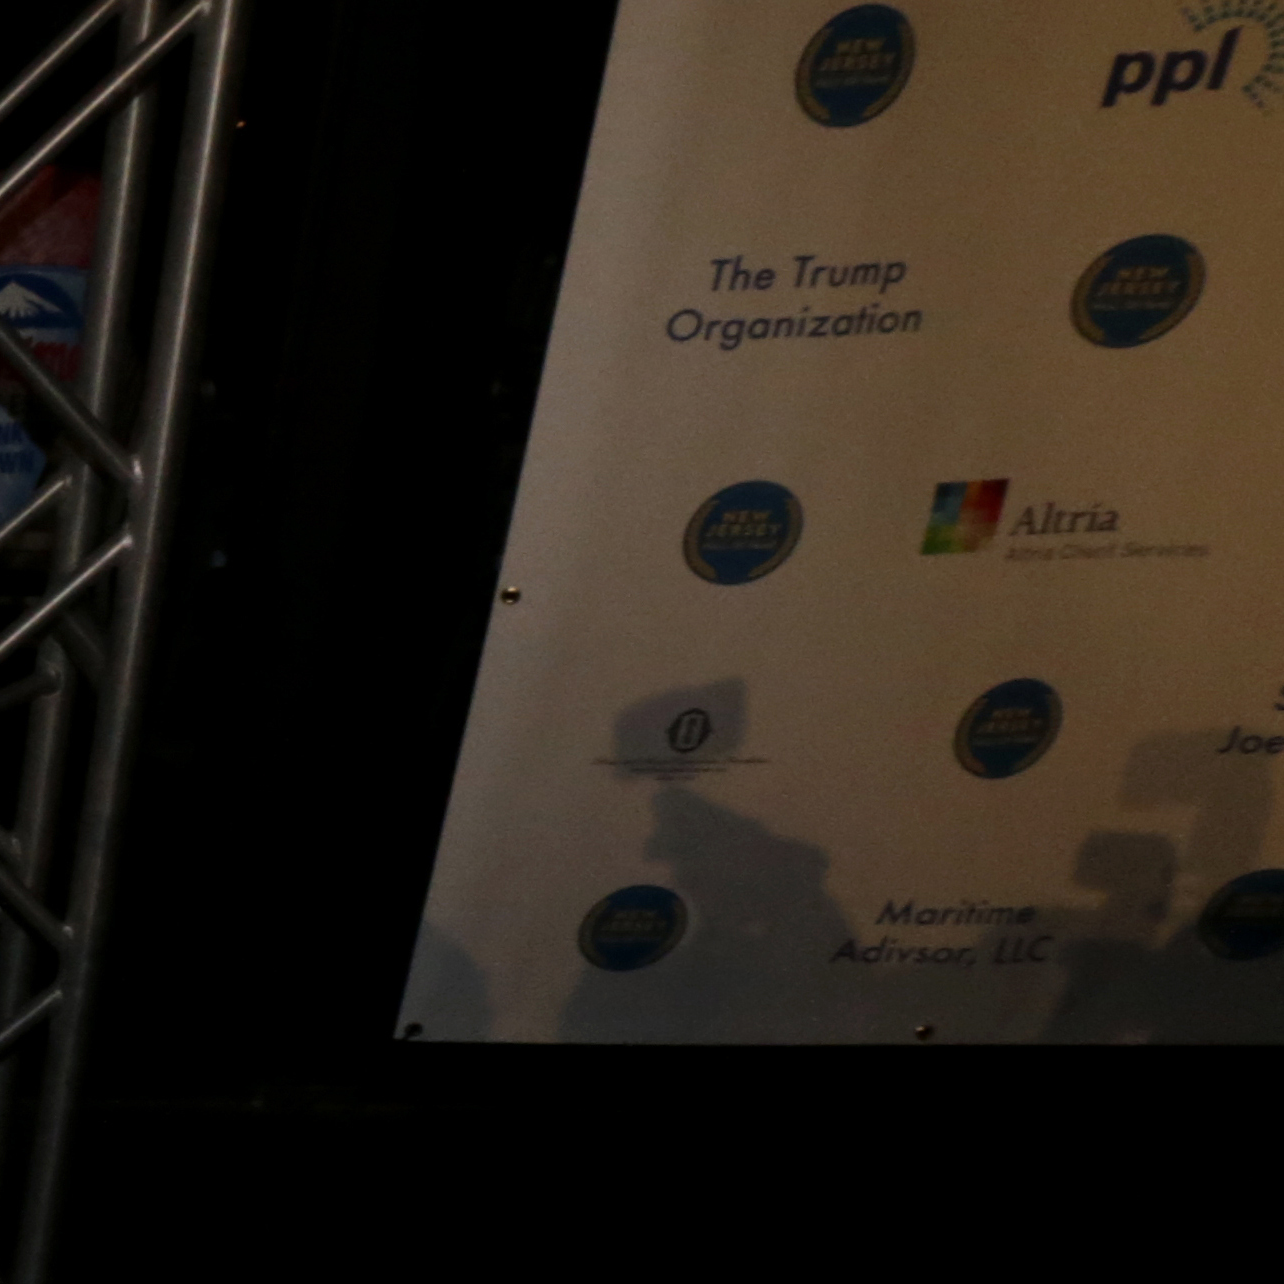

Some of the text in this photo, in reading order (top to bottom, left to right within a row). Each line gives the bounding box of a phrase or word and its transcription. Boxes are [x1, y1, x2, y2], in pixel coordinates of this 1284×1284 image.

[1101, 25, 1244, 108] ppl
[711, 254, 907, 295] The Trump
[666, 303, 923, 352] Organization
[705, 523, 783, 537] JERSEY
[722, 509, 773, 523] NEW
[1009, 501, 1119, 536] Altria
[875, 899, 1036, 926] Maritime
[993, 935, 1055, 964] LLC
